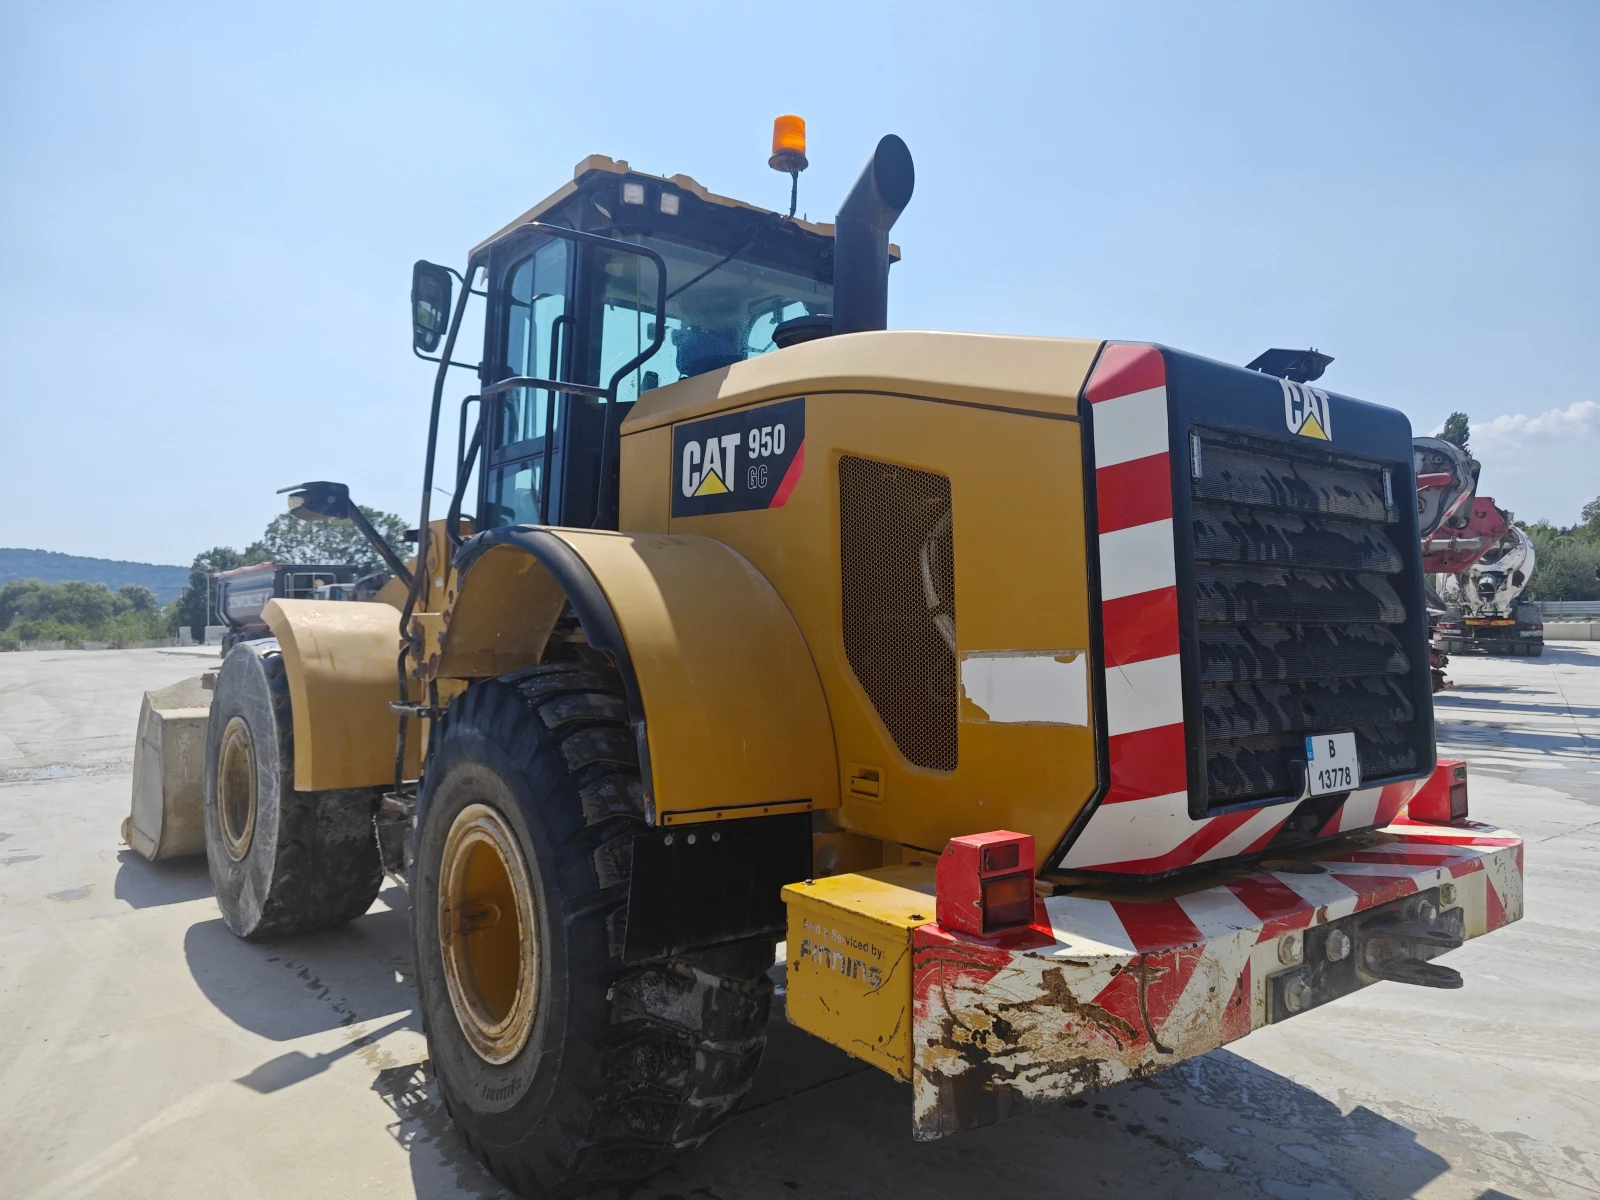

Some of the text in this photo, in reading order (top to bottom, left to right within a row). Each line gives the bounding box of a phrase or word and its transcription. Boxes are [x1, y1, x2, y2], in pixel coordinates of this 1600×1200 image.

[1279, 379, 1332, 441] CAT
[682, 423, 786, 498] CAT 950
[747, 464, 768, 490] GC
[1328, 739, 1336, 758] B
[1318, 766, 1351, 789] 13778
[831, 929, 869, 953] Serviced
[871, 943, 886, 960] by:
